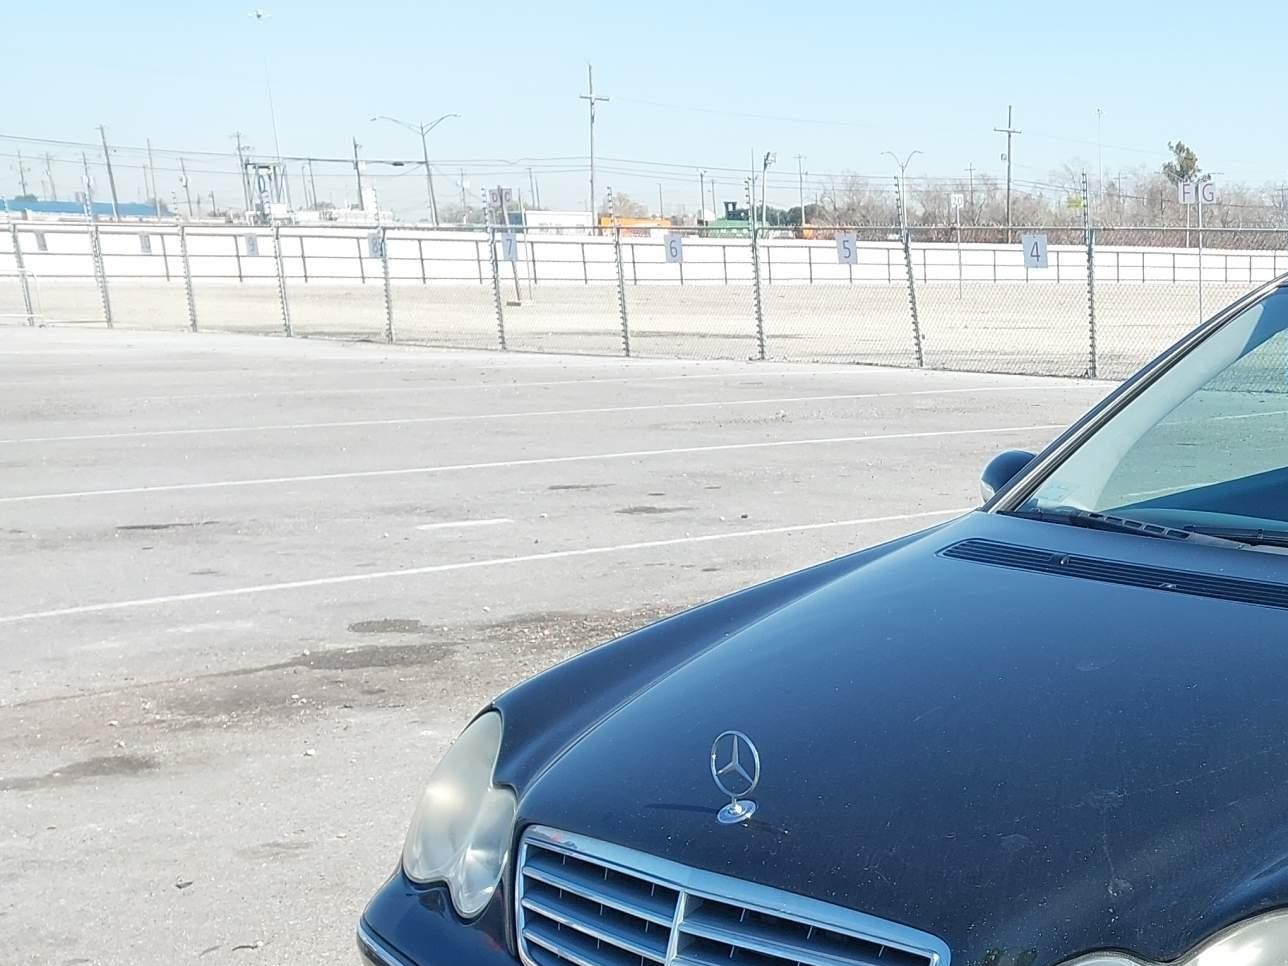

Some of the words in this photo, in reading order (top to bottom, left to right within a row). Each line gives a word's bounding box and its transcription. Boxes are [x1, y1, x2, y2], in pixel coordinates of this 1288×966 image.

[1182, 183, 1191, 203] F
[1202, 183, 1215, 203] G
[506, 238, 513, 256] 7
[669, 239, 678, 258] 6
[842, 240, 852, 259] 5
[1030, 241, 1041, 262] 4
